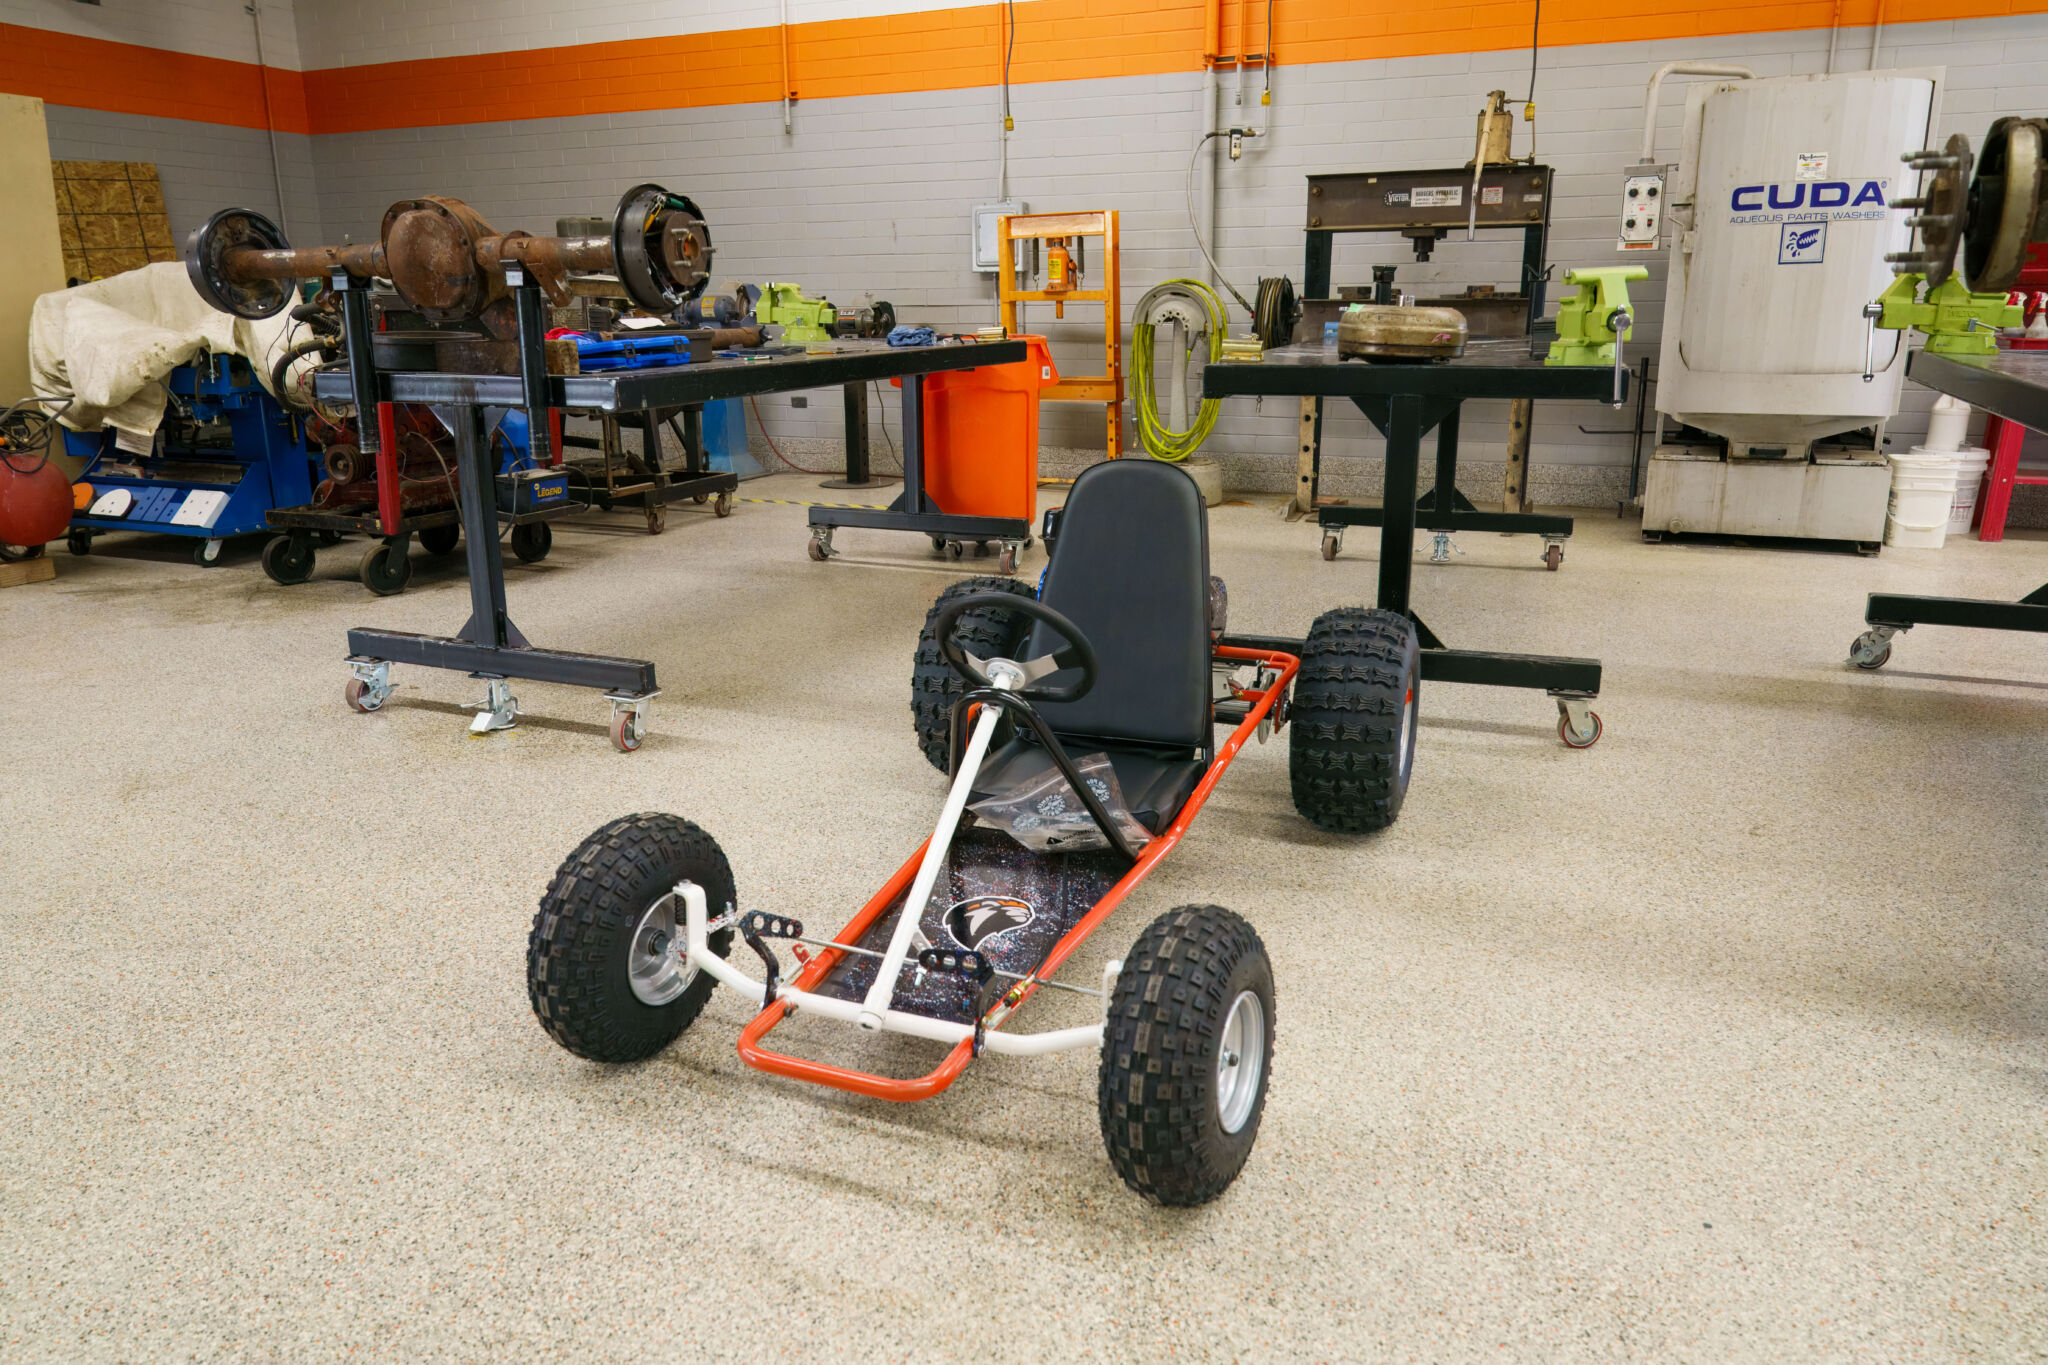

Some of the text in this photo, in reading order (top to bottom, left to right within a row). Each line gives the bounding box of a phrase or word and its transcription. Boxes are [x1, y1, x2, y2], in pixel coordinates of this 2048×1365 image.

[1731, 181, 1885, 212] CUDA
[1730, 210, 1886, 224] AQUEOUS PARTS WASHERS
[537, 486, 562, 498] LEGEND
